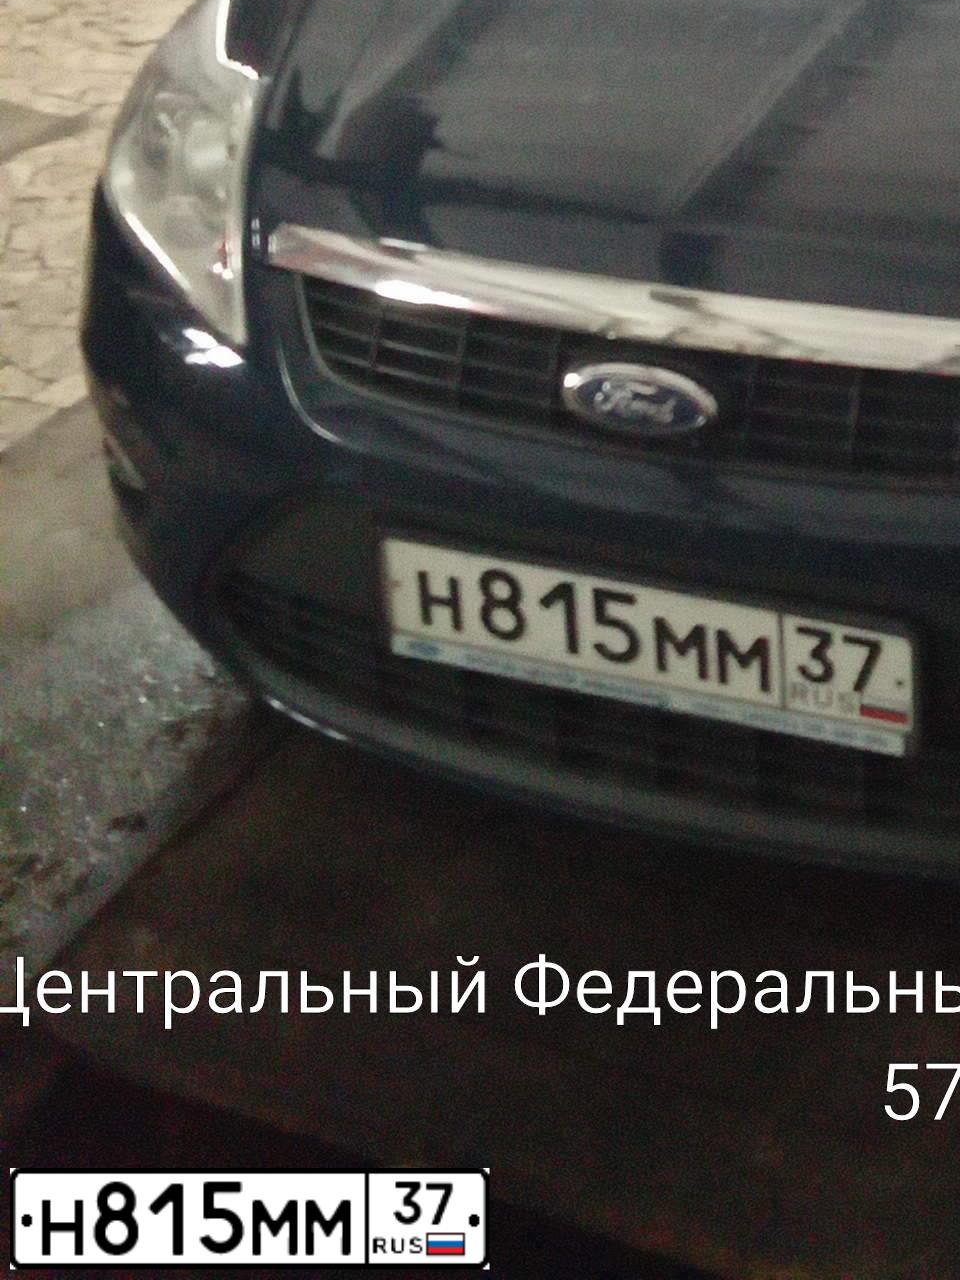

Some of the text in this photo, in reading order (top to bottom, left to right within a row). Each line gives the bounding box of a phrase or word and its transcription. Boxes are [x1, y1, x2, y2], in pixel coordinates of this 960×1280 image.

[416, 568, 773, 694] Н815ММ
[796, 626, 882, 692] 37
[790, 681, 856, 714] RUS
